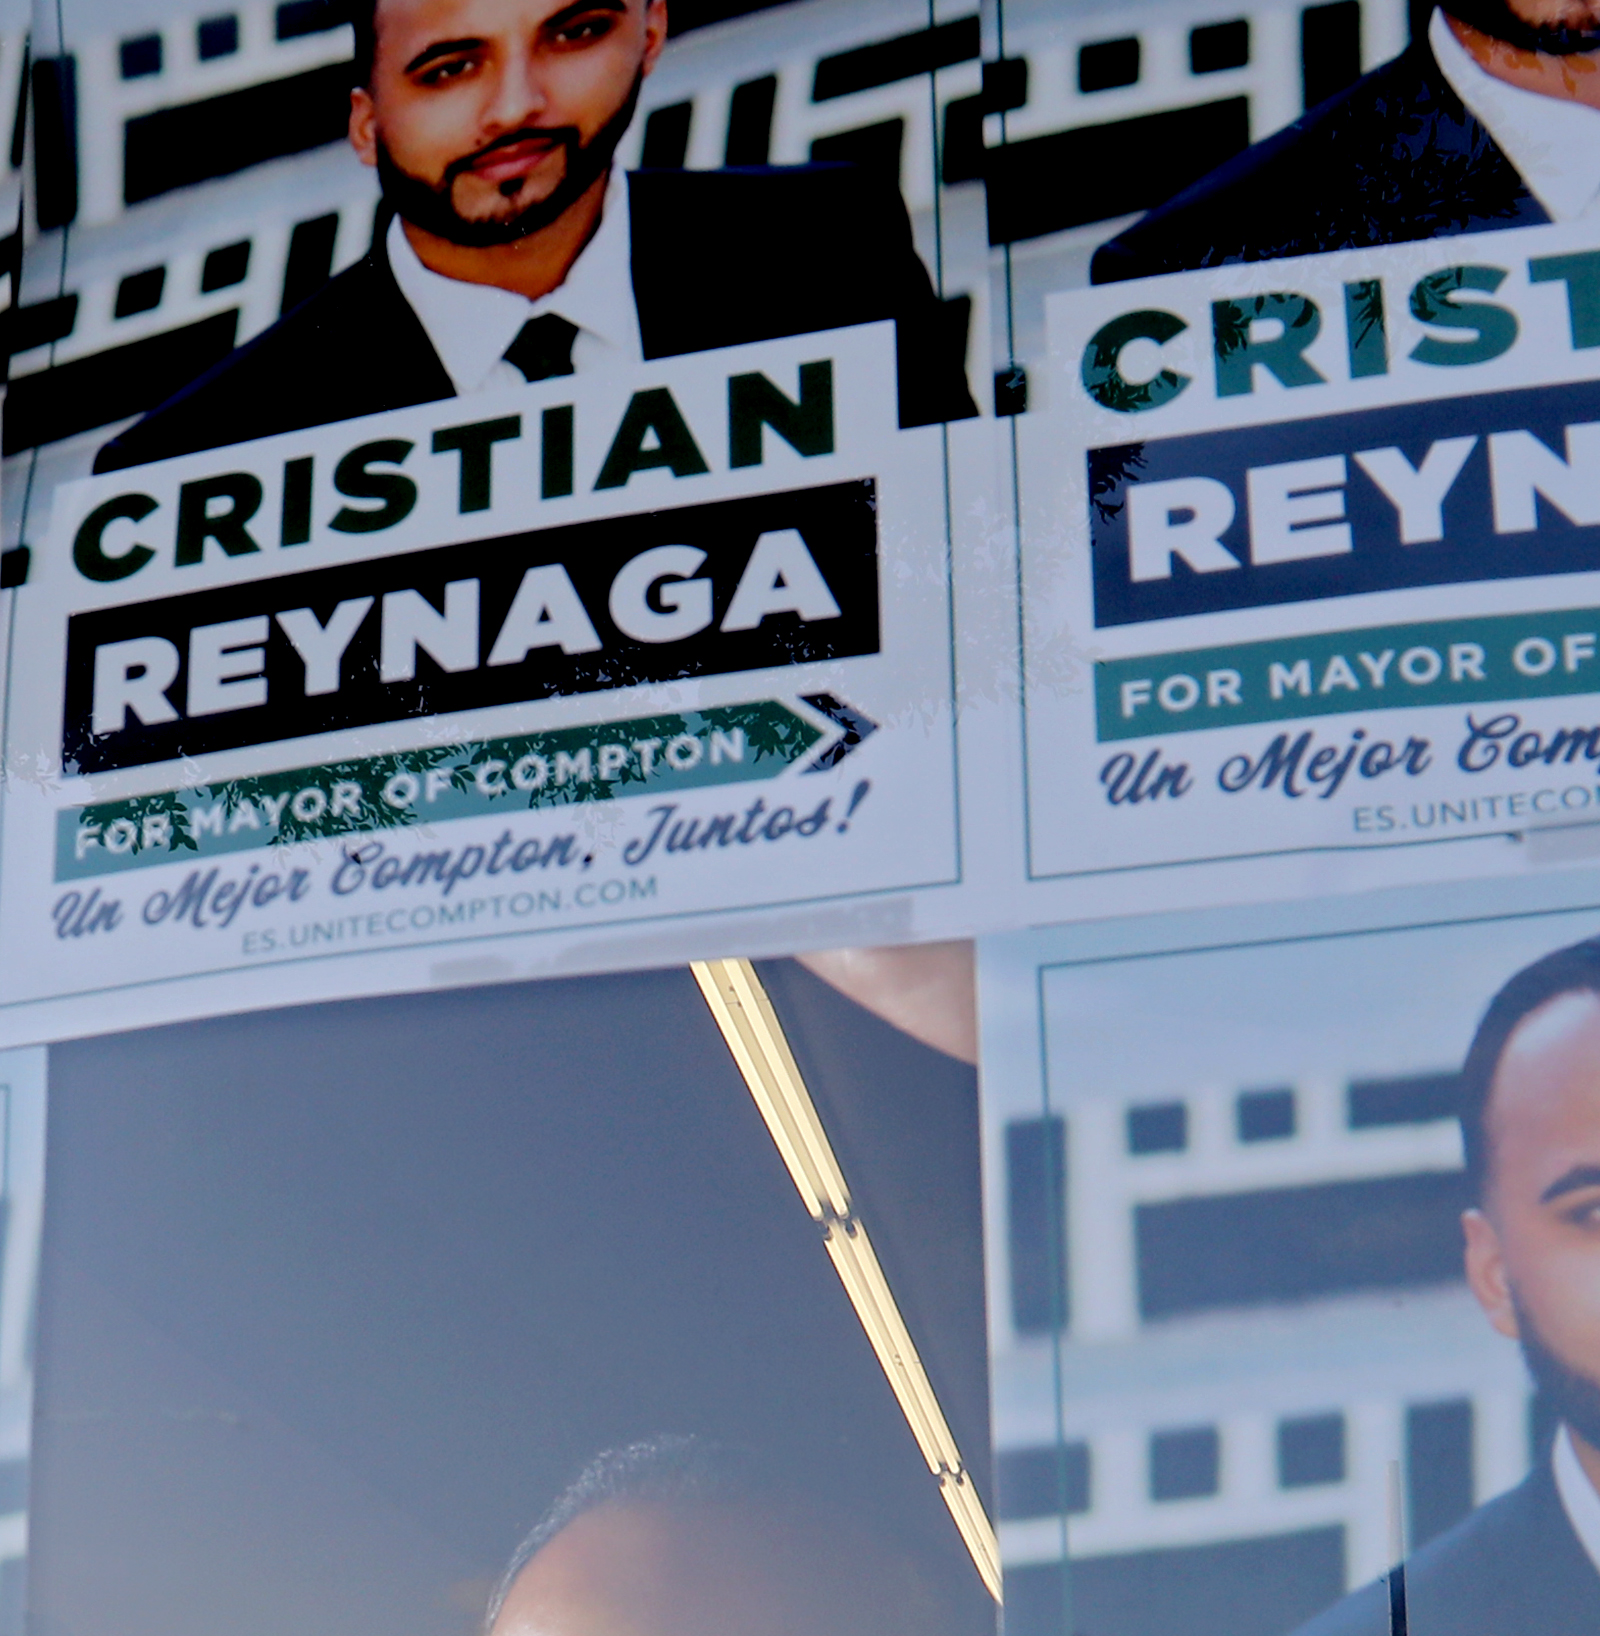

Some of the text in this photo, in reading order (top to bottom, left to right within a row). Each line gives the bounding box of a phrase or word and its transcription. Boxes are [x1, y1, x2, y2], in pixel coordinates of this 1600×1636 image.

[71, 358, 835, 583] CRISTIAN
[92, 528, 841, 736] REYNAGA
[1119, 664, 1245, 720] FOR
[1269, 641, 1487, 703] MAYOR
[1513, 630, 1599, 679] OF
[74, 726, 744, 861] FOR MAYOR OF COMPTON
[1098, 748, 1194, 808] Un
[1217, 723, 1434, 802] Mejor
[51, 778, 871, 939] Un Mejor Compton, Juntos!
[241, 876, 658, 956] ES.UNITECOMPTON.COM
